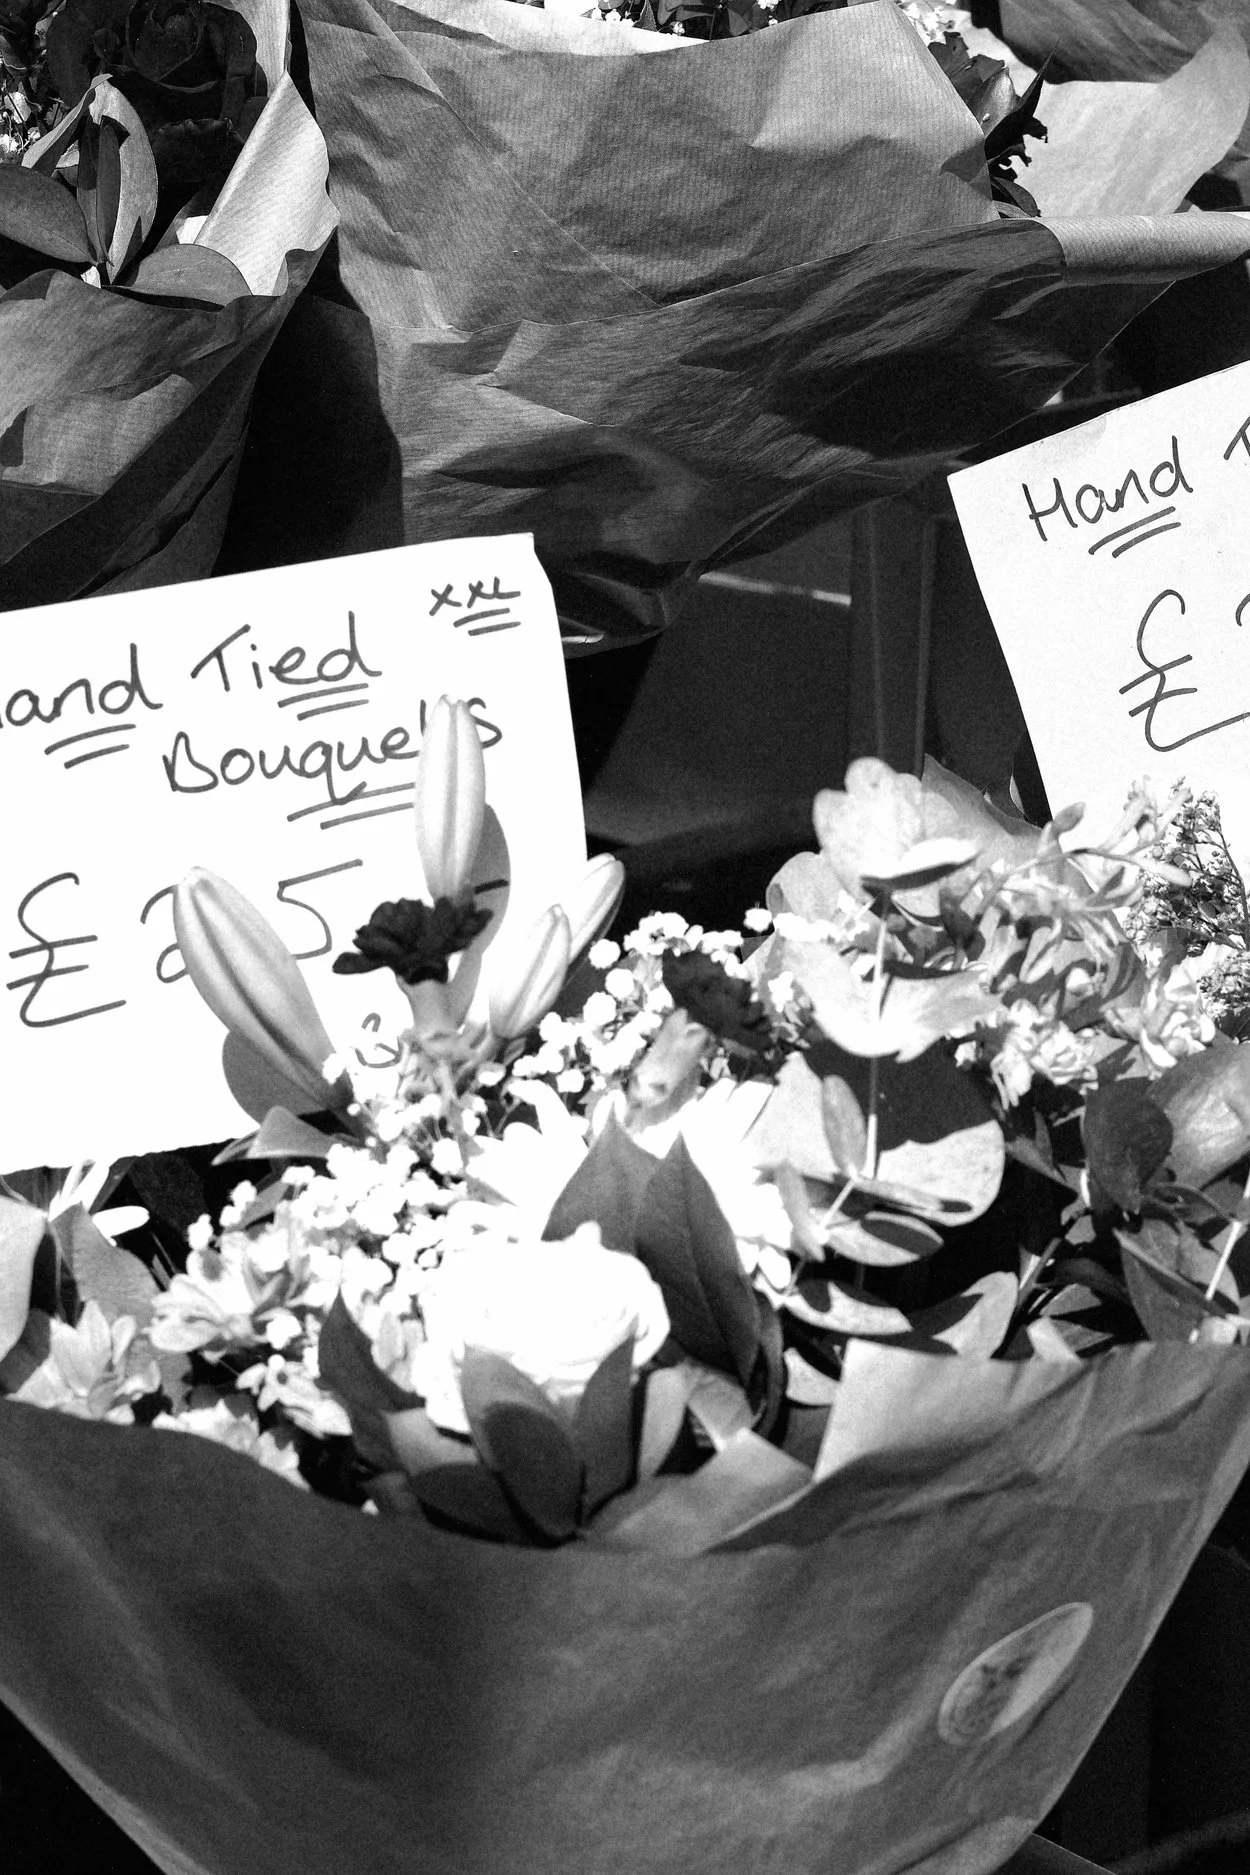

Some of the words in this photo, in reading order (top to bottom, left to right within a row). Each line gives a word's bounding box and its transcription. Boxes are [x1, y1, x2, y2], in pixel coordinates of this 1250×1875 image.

[1021, 435, 1194, 541] Hand
[0, 642, 164, 728] and
[190, 611, 382, 692] Tied
